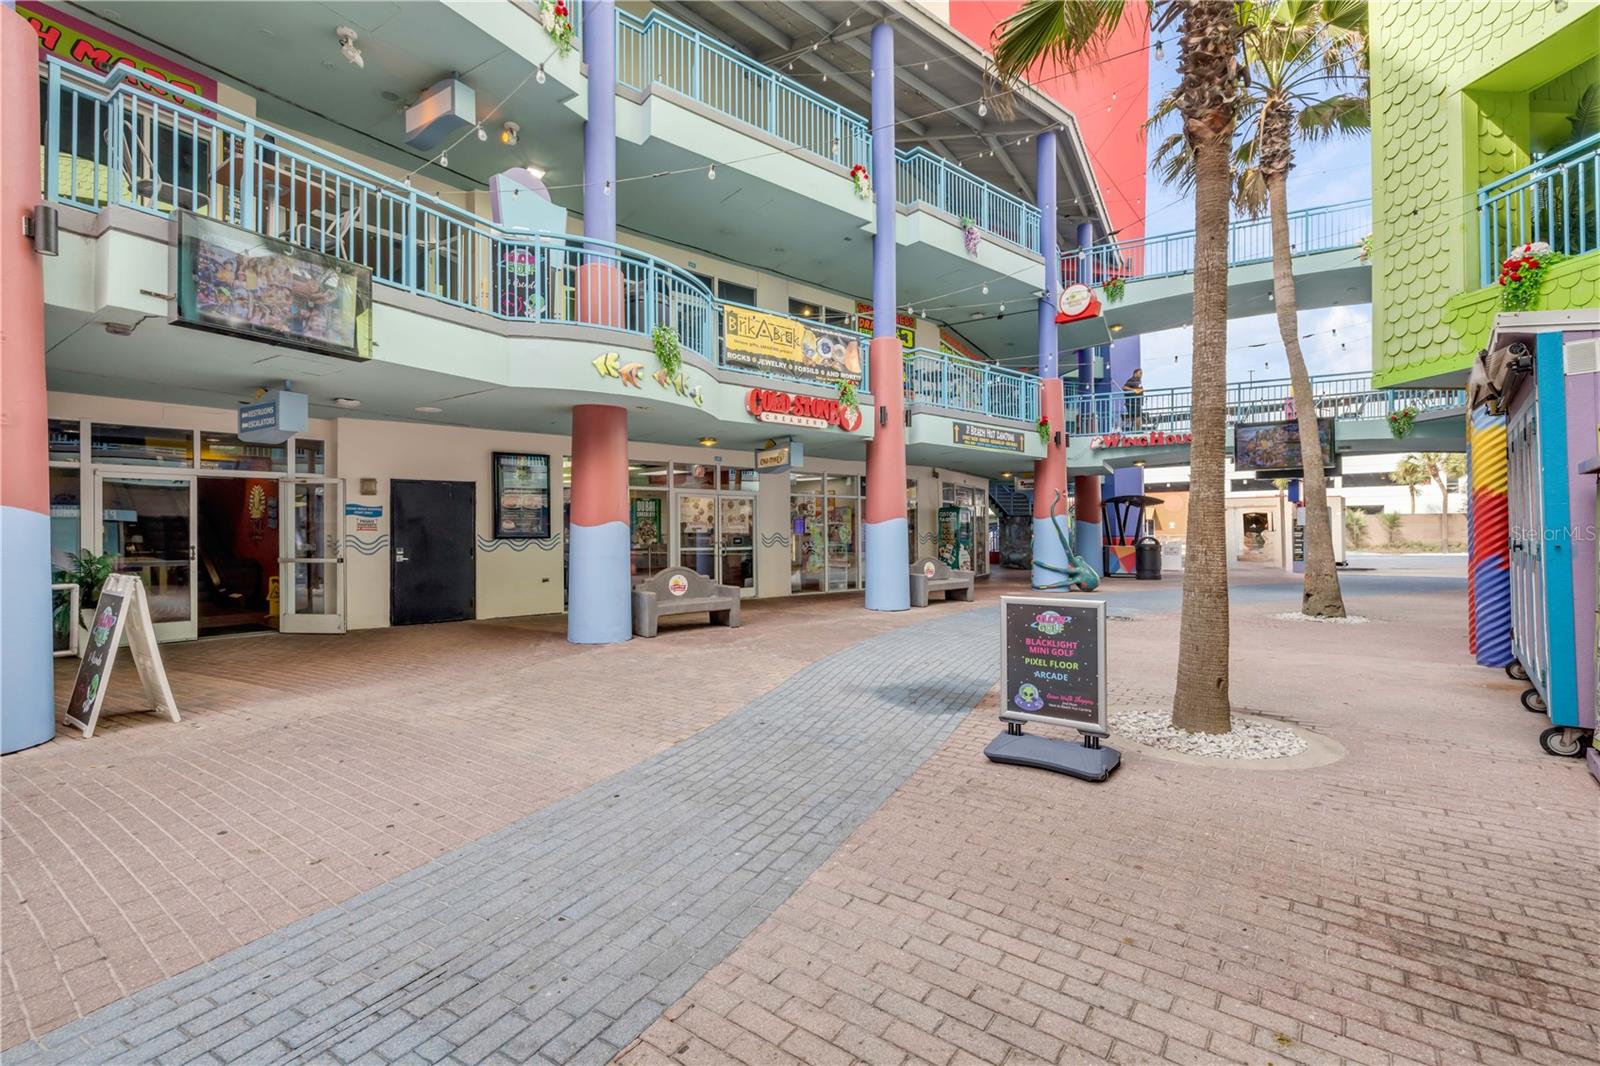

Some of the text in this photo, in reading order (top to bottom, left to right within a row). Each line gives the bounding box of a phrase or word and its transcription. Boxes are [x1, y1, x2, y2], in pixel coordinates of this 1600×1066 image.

[70, 39, 197, 104] MART
[726, 351, 751, 362] ROCKS
[758, 357, 787, 369] JEWELRY
[794, 364, 819, 376] FOSSILS
[826, 371, 840, 379] AND
[248, 406, 274, 417] RESTROOMS
[748, 387, 841, 425] COLD STONE
[248, 417, 276, 428] ESCALATORS
[765, 413, 825, 427] CREAMERY
[1036, 614, 1066, 625] GLOW
[1038, 624, 1064, 633] GOLF
[1025, 638, 1078, 649] BLACKLIGHT
[1029, 645, 1075, 657] MINI GOLF
[1025, 658, 1079, 670] PIXEL FLOOR
[1034, 671, 1068, 681] ARCADE
